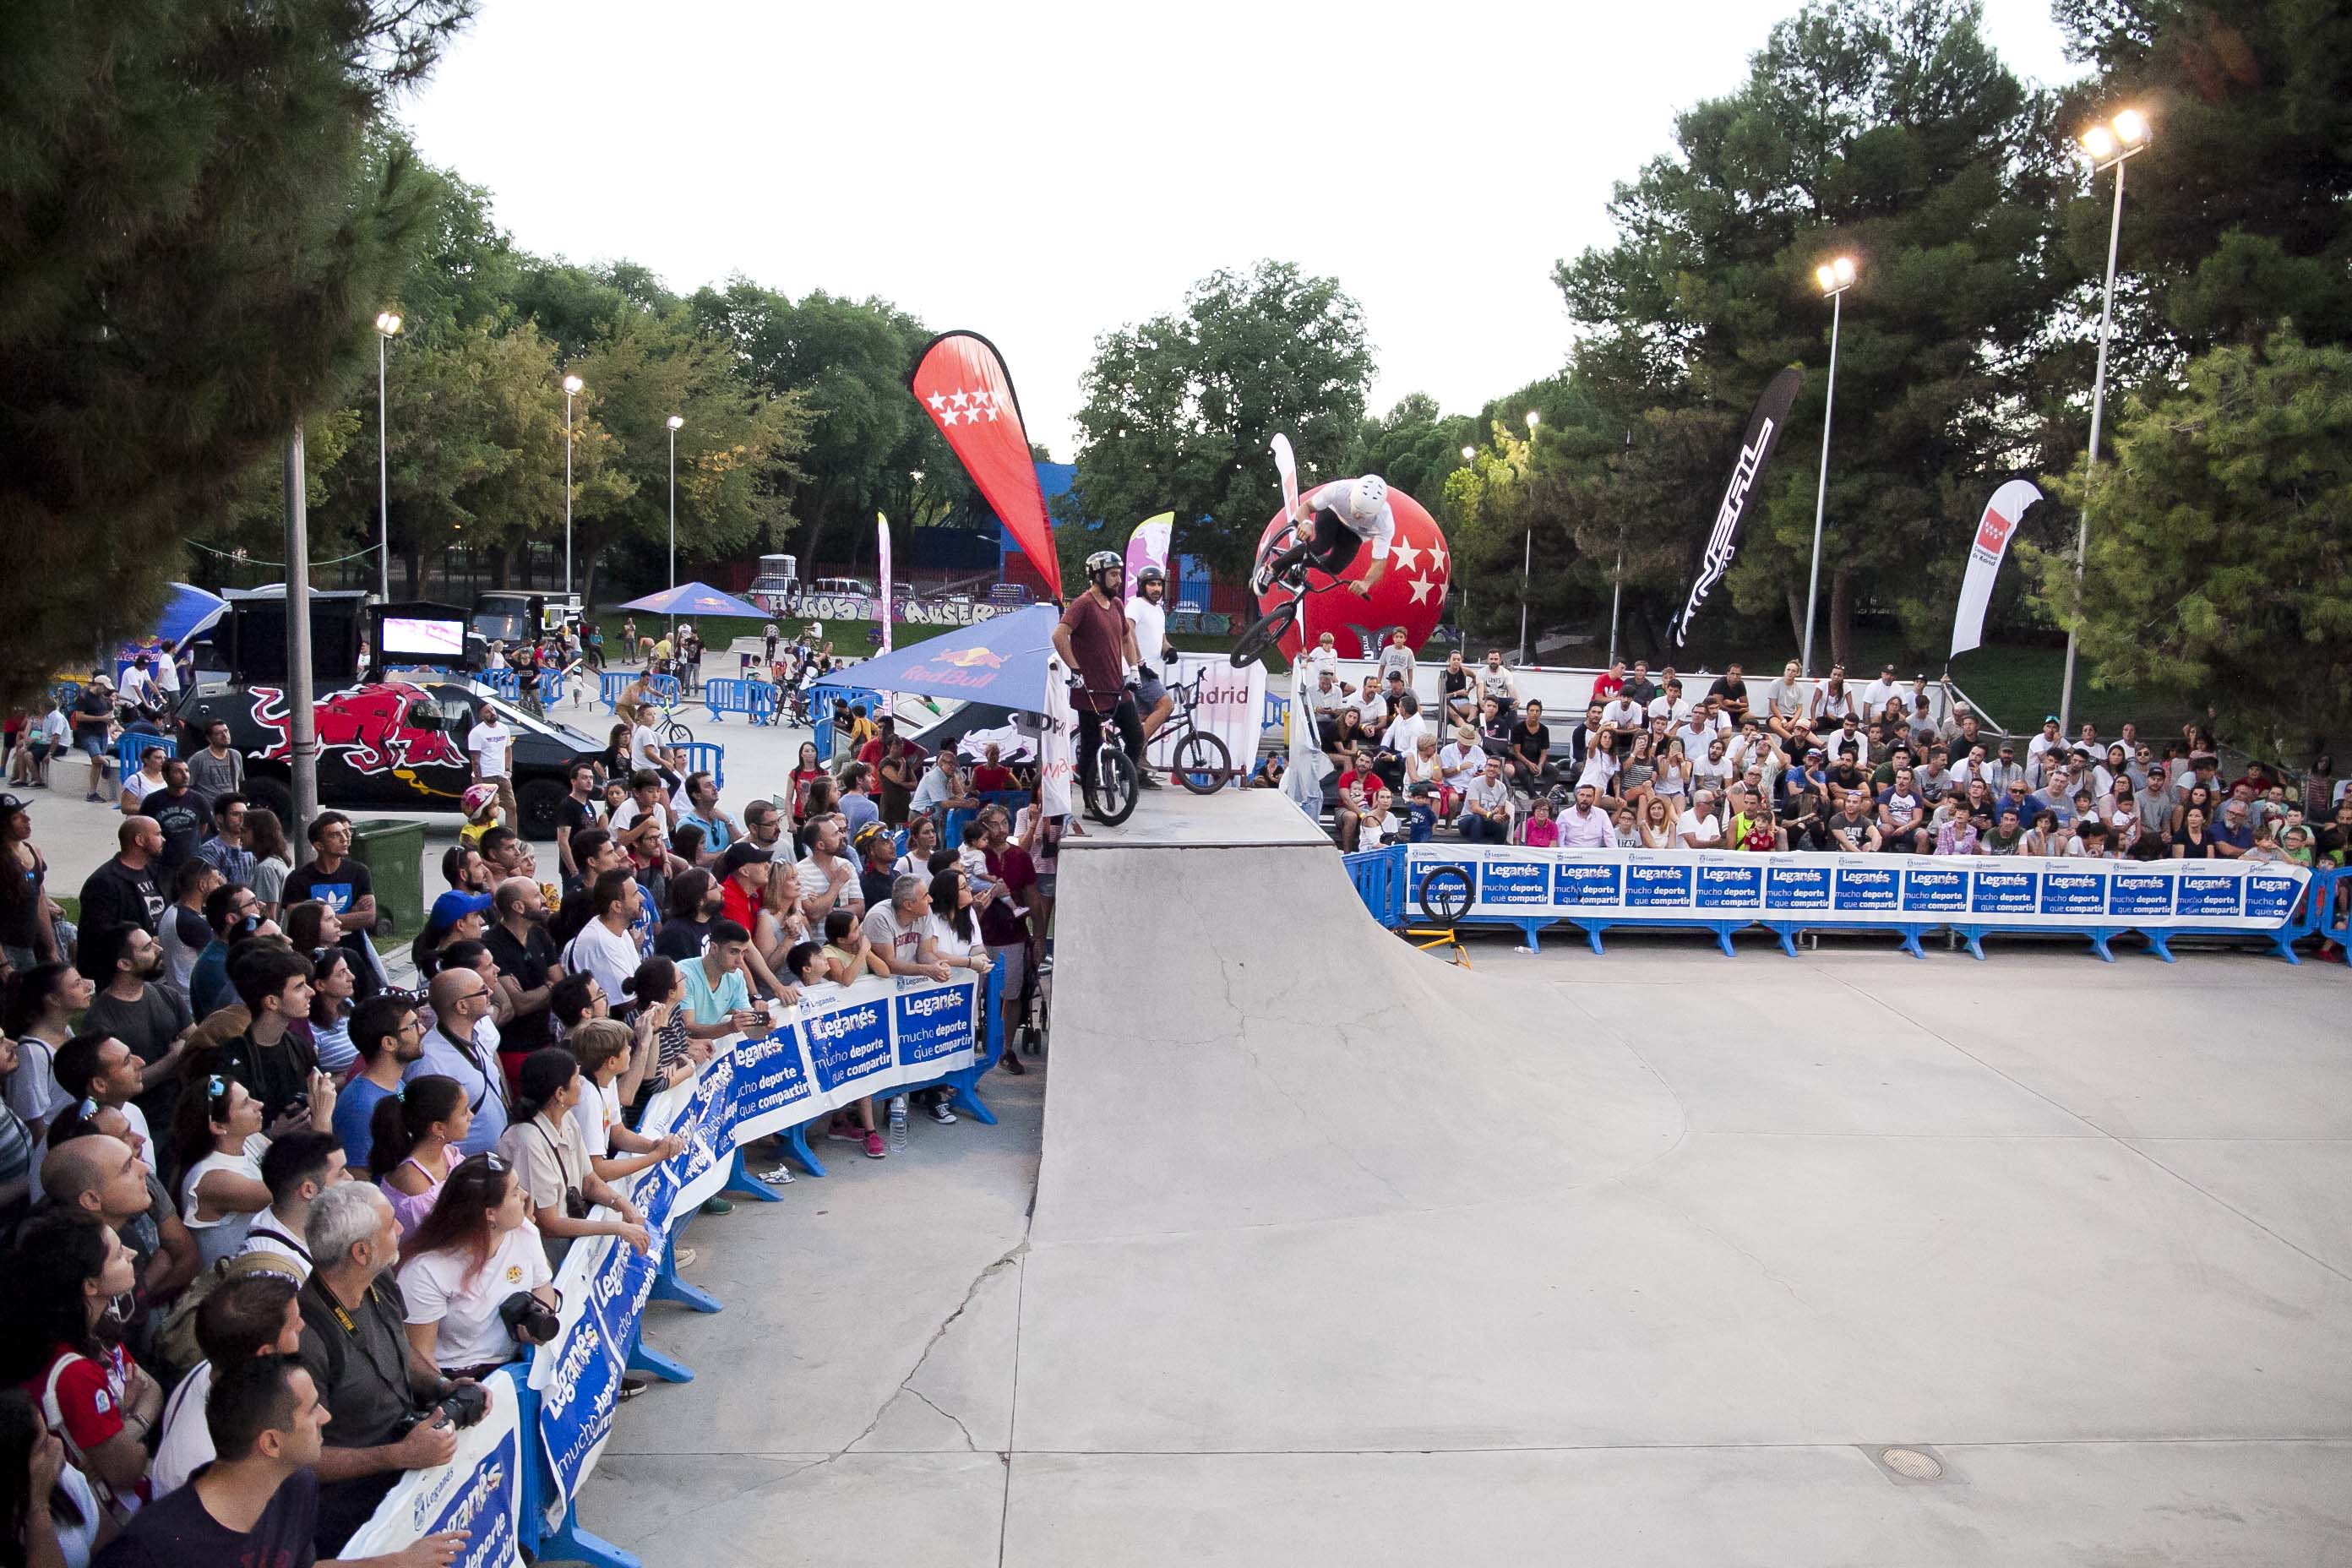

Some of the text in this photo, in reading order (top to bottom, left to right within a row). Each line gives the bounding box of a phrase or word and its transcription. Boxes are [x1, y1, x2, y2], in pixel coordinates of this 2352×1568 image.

[901, 665, 999, 688] Red Bull
[1489, 863, 1539, 877] Leganés
[1561, 866, 1612, 879] Leganés
[1633, 866, 1682, 880] Leganés
[1703, 868, 1752, 881] Leganés
[1773, 868, 1821, 883] Leganés
[1843, 870, 1891, 884] Leganés
[1911, 872, 1960, 885] Leganés
[1980, 873, 2028, 887] Leganés
[2049, 874, 2096, 889] Leganés
[2117, 876, 2164, 890] Leganés
[2185, 877, 2232, 890] Leganés
[1439, 883, 1467, 891] deport
[1511, 884, 1543, 893] deporte
[1583, 885, 1614, 894] deporte
[1654, 887, 1685, 896] deporte
[1724, 888, 1755, 896] deporte
[1794, 889, 1824, 898] deporte
[1508, 894, 1548, 903] compartir
[1863, 890, 1893, 899] deporte
[1931, 892, 1962, 901] deporte
[2000, 893, 2030, 902] deporte
[2069, 895, 2099, 904] deporte
[2137, 896, 2167, 905] deporte
[2203, 896, 2235, 905] deporte
[1651, 897, 1690, 906] compartir
[1721, 898, 1760, 907] compartir
[1791, 900, 1829, 909] compartir
[1859, 901, 1897, 910] compartir
[1928, 901, 1966, 911] compartir
[1997, 903, 2035, 912] compartir
[2066, 905, 2104, 914] compartir
[2133, 906, 2171, 915] compartir
[2201, 906, 2239, 916] compartir
[906, 977, 928, 986] Leganés
[905, 988, 964, 1016] Leganés
[810, 1007, 878, 1040] Leganés
[899, 1020, 967, 1044] mucho deporte
[736, 1035, 784, 1068] eganés
[814, 1038, 884, 1069] mucho deporte
[914, 1035, 972, 1061] que compartir
[832, 1052, 891, 1085] que compartir
[759, 1068, 798, 1089] deporte
[739, 1081, 810, 1119] que compartir
[718, 1135, 730, 1152] que
[632, 1266, 656, 1316] deporte
[441, 1462, 504, 1535] ganés
